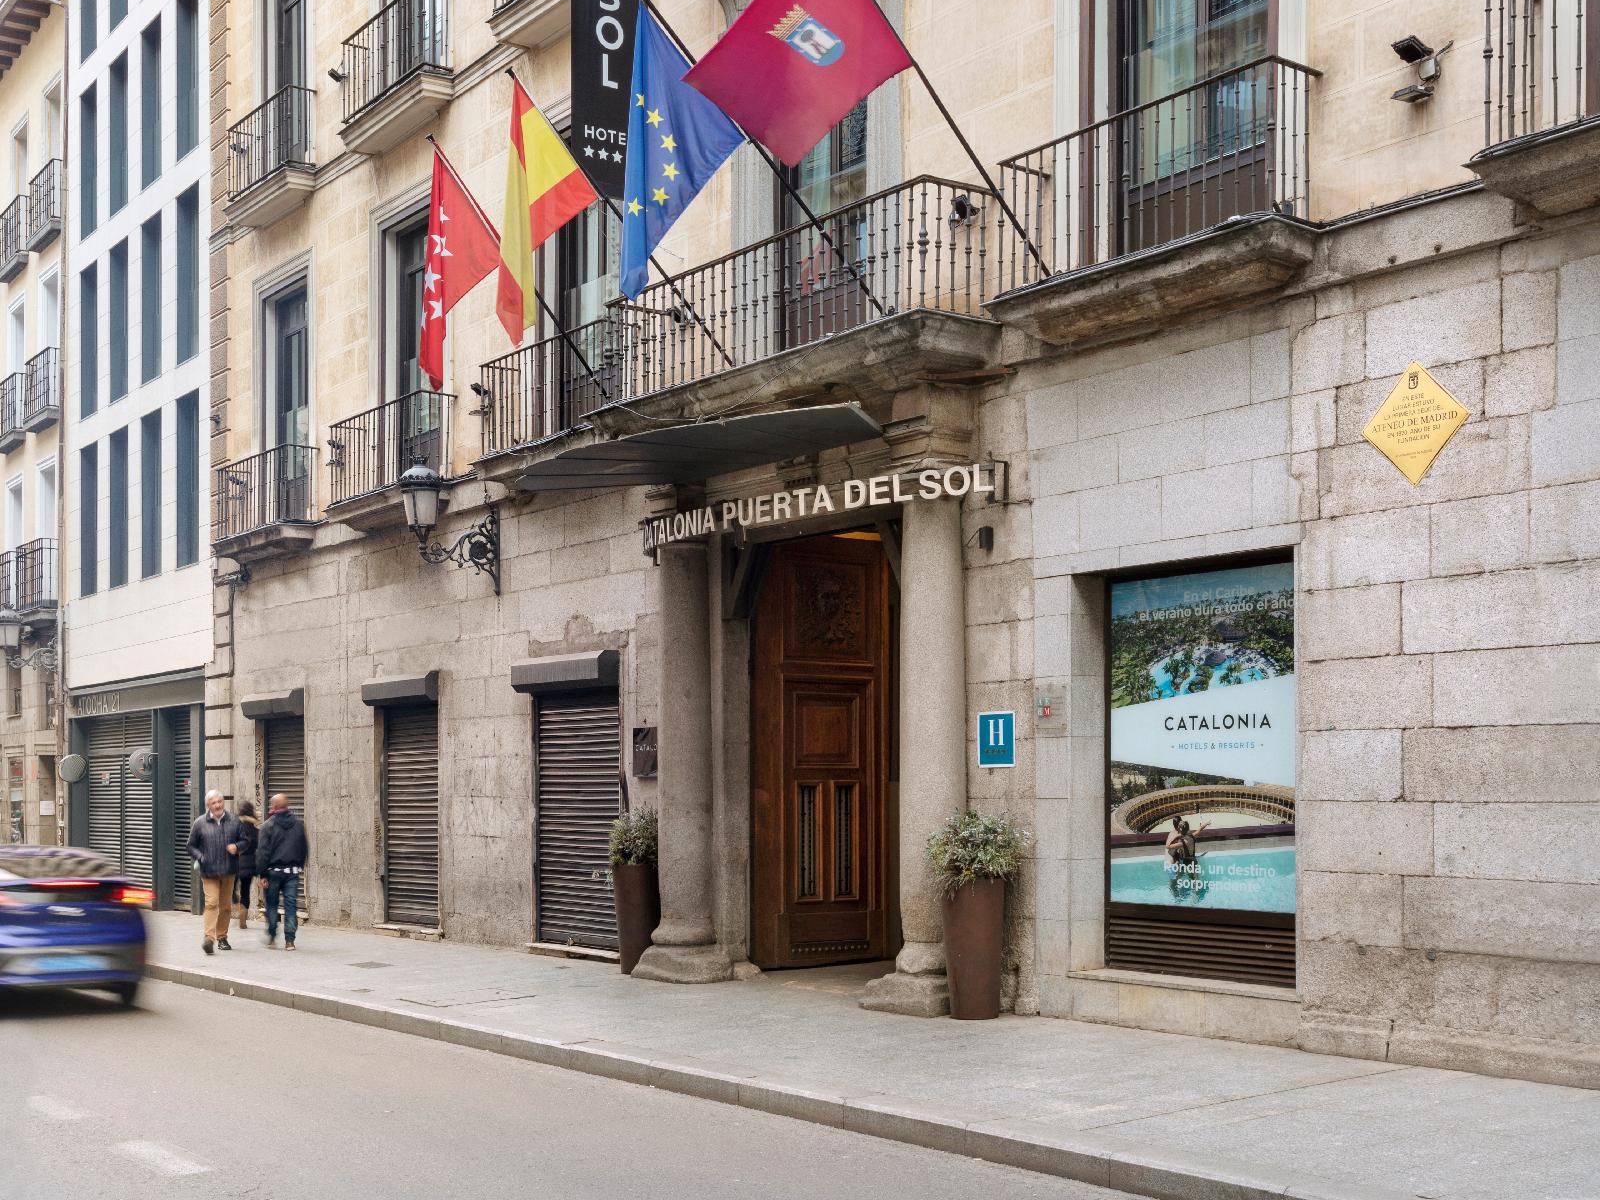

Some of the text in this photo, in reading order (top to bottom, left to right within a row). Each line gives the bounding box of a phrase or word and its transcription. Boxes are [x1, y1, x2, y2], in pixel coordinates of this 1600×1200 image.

[584, 124, 627, 146] HOTE
[1372, 410, 1458, 434] ATENEO DE MADRID
[643, 463, 995, 551] CATALONIA PUERTA DEL SOL
[1184, 584, 1256, 602] En el Caribe
[1139, 595, 1294, 622] el verano dura todo el año
[77, 692, 120, 716] ATOCHA 21
[988, 718, 1005, 746] H
[1164, 713, 1272, 731] CATALONIA
[1178, 741, 1256, 750] HOTELS & RESORTS
[1163, 860, 1276, 878] Ronda, un destino
